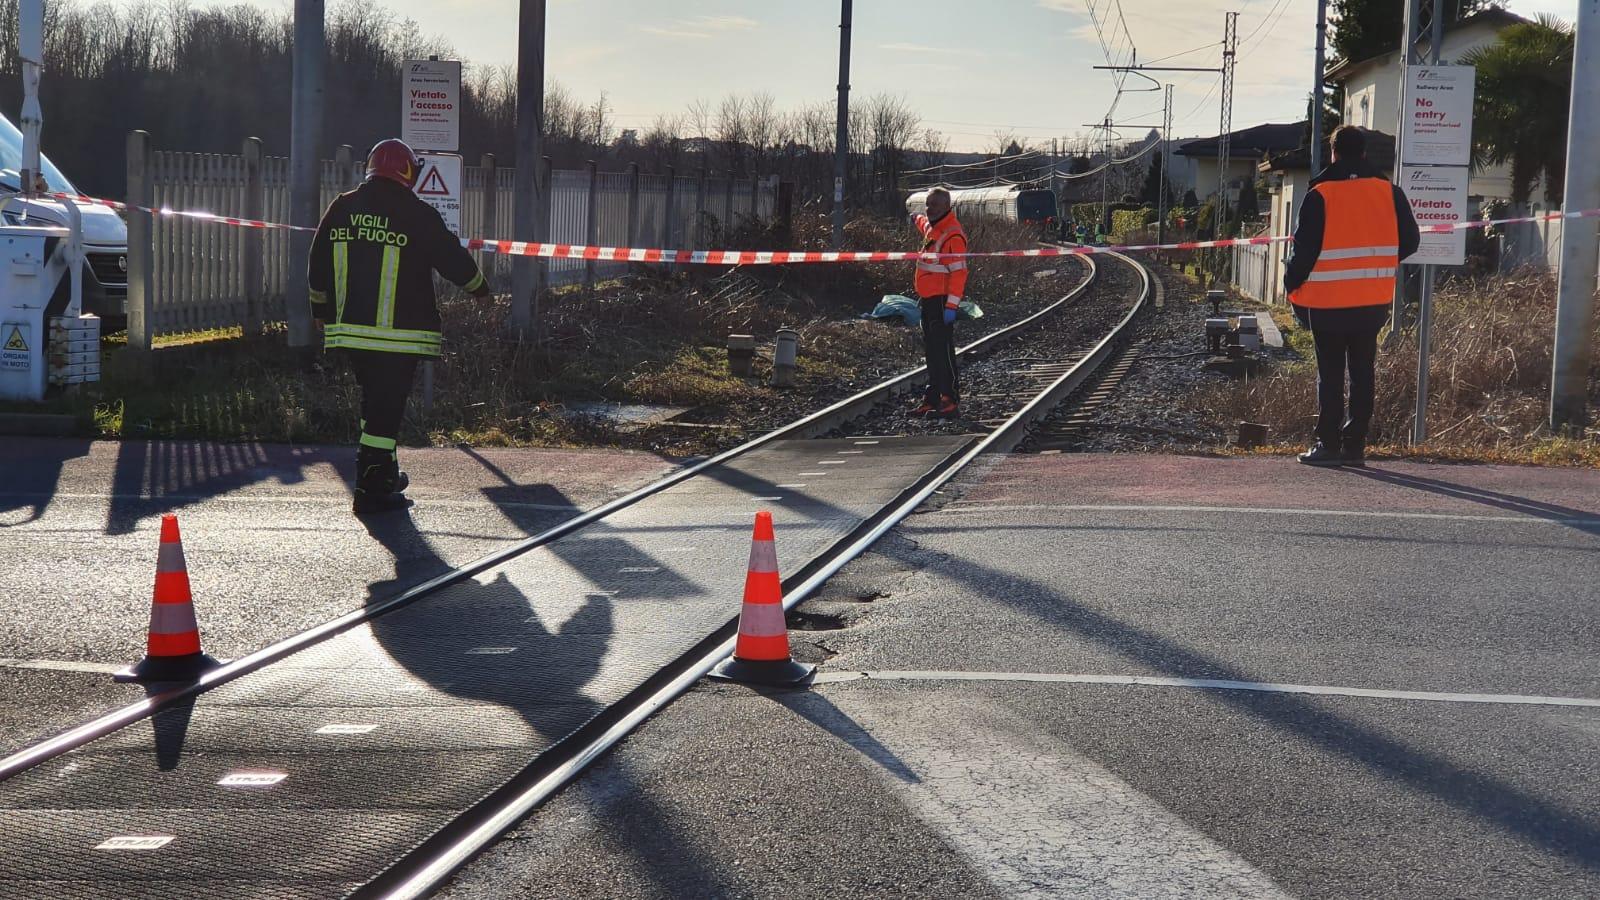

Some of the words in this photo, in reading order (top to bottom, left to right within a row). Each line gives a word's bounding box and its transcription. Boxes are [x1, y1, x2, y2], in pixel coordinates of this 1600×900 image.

[410, 89, 447, 99] Vietato
[410, 100, 453, 110] l'accesso
[1415, 98, 1433, 107] No
[1414, 110, 1446, 121] entry
[1410, 199, 1452, 208] Vietato
[1413, 210, 1459, 220] 'accesso
[350, 214, 389, 229] VIGILI
[329, 228, 354, 240] DEL
[357, 228, 408, 246] FUOCO
[3, 352, 29, 360] ORGANI
